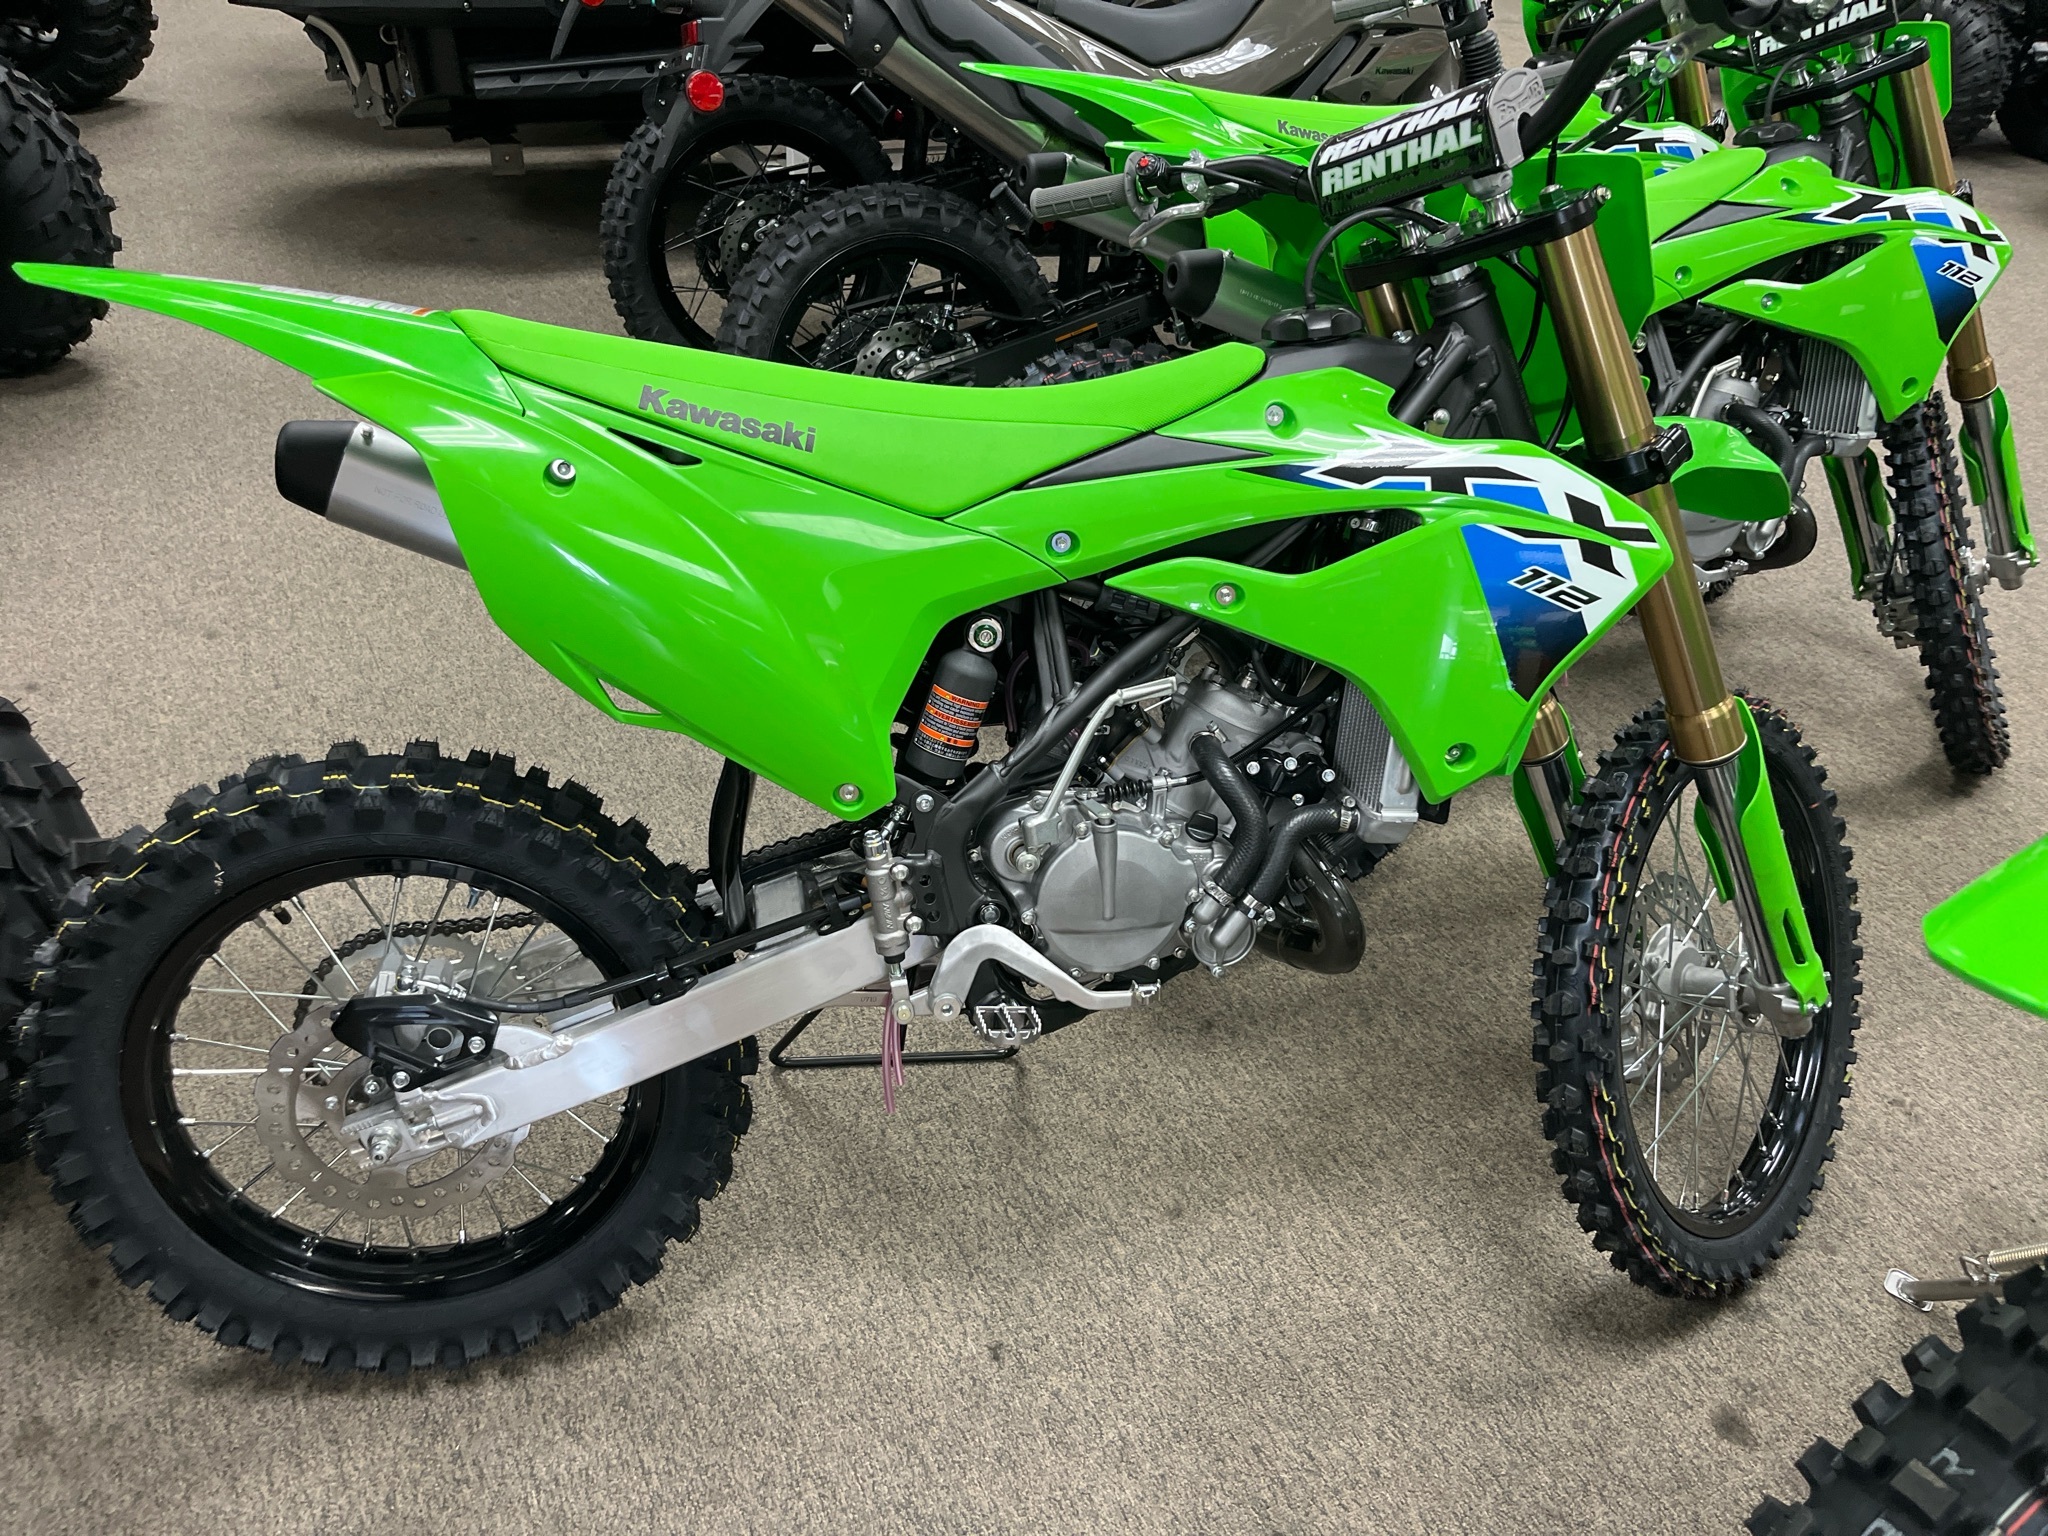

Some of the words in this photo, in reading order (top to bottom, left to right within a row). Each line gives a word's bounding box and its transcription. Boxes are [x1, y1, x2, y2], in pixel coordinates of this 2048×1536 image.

[1374, 65, 1415, 76] Kawasaki
[1317, 91, 1485, 167] RENTHAL
[1321, 117, 1483, 198] RENTHAL
[1936, 259, 1984, 288] 112
[637, 383, 818, 454] Kawasaki
[1506, 564, 1603, 614] 112
[950, 695, 980, 709] WARNING
